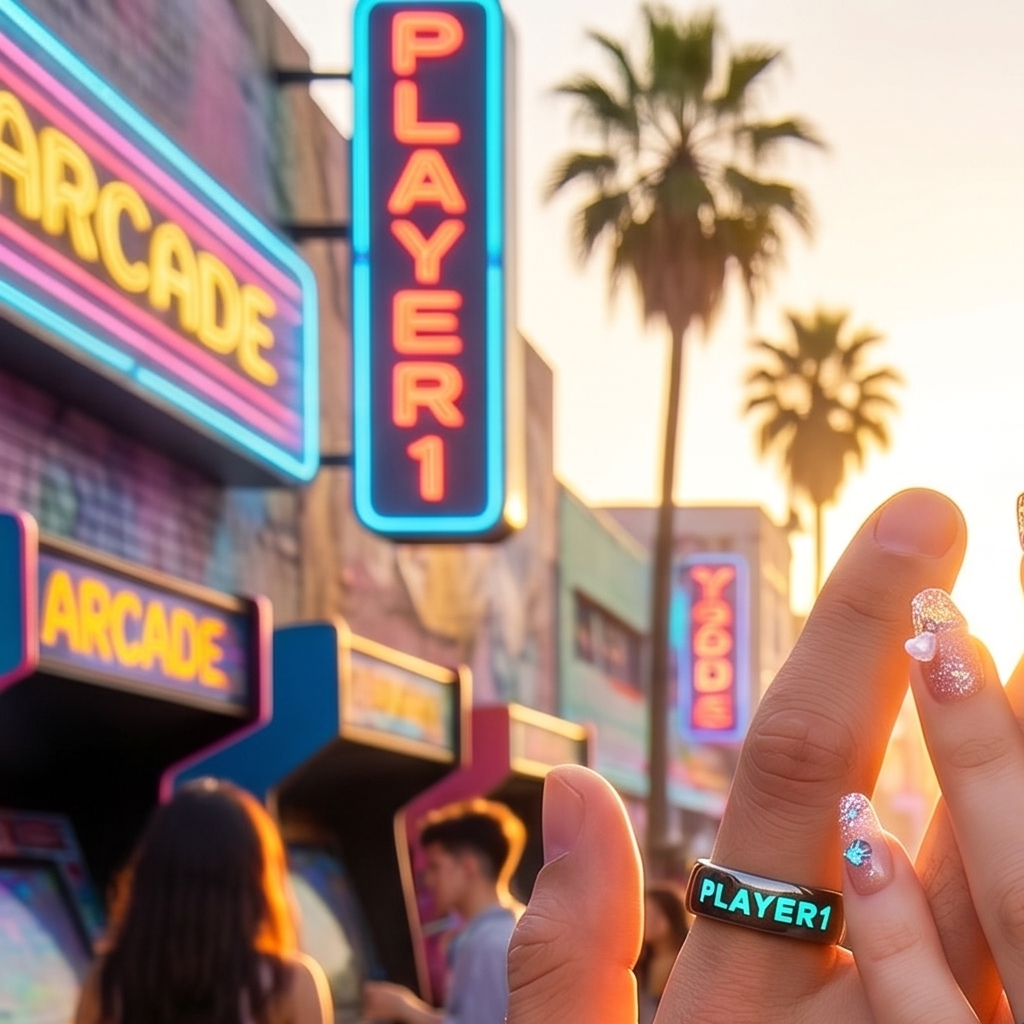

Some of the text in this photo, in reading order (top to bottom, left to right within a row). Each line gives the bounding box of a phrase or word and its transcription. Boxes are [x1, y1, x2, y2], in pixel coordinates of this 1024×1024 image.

[0, 89, 278, 386] ARCADE
[388, 11, 466, 502] PLAYER1
[41, 568, 229, 689] ARCADE
[699, 878, 832, 931] PLAYER1
